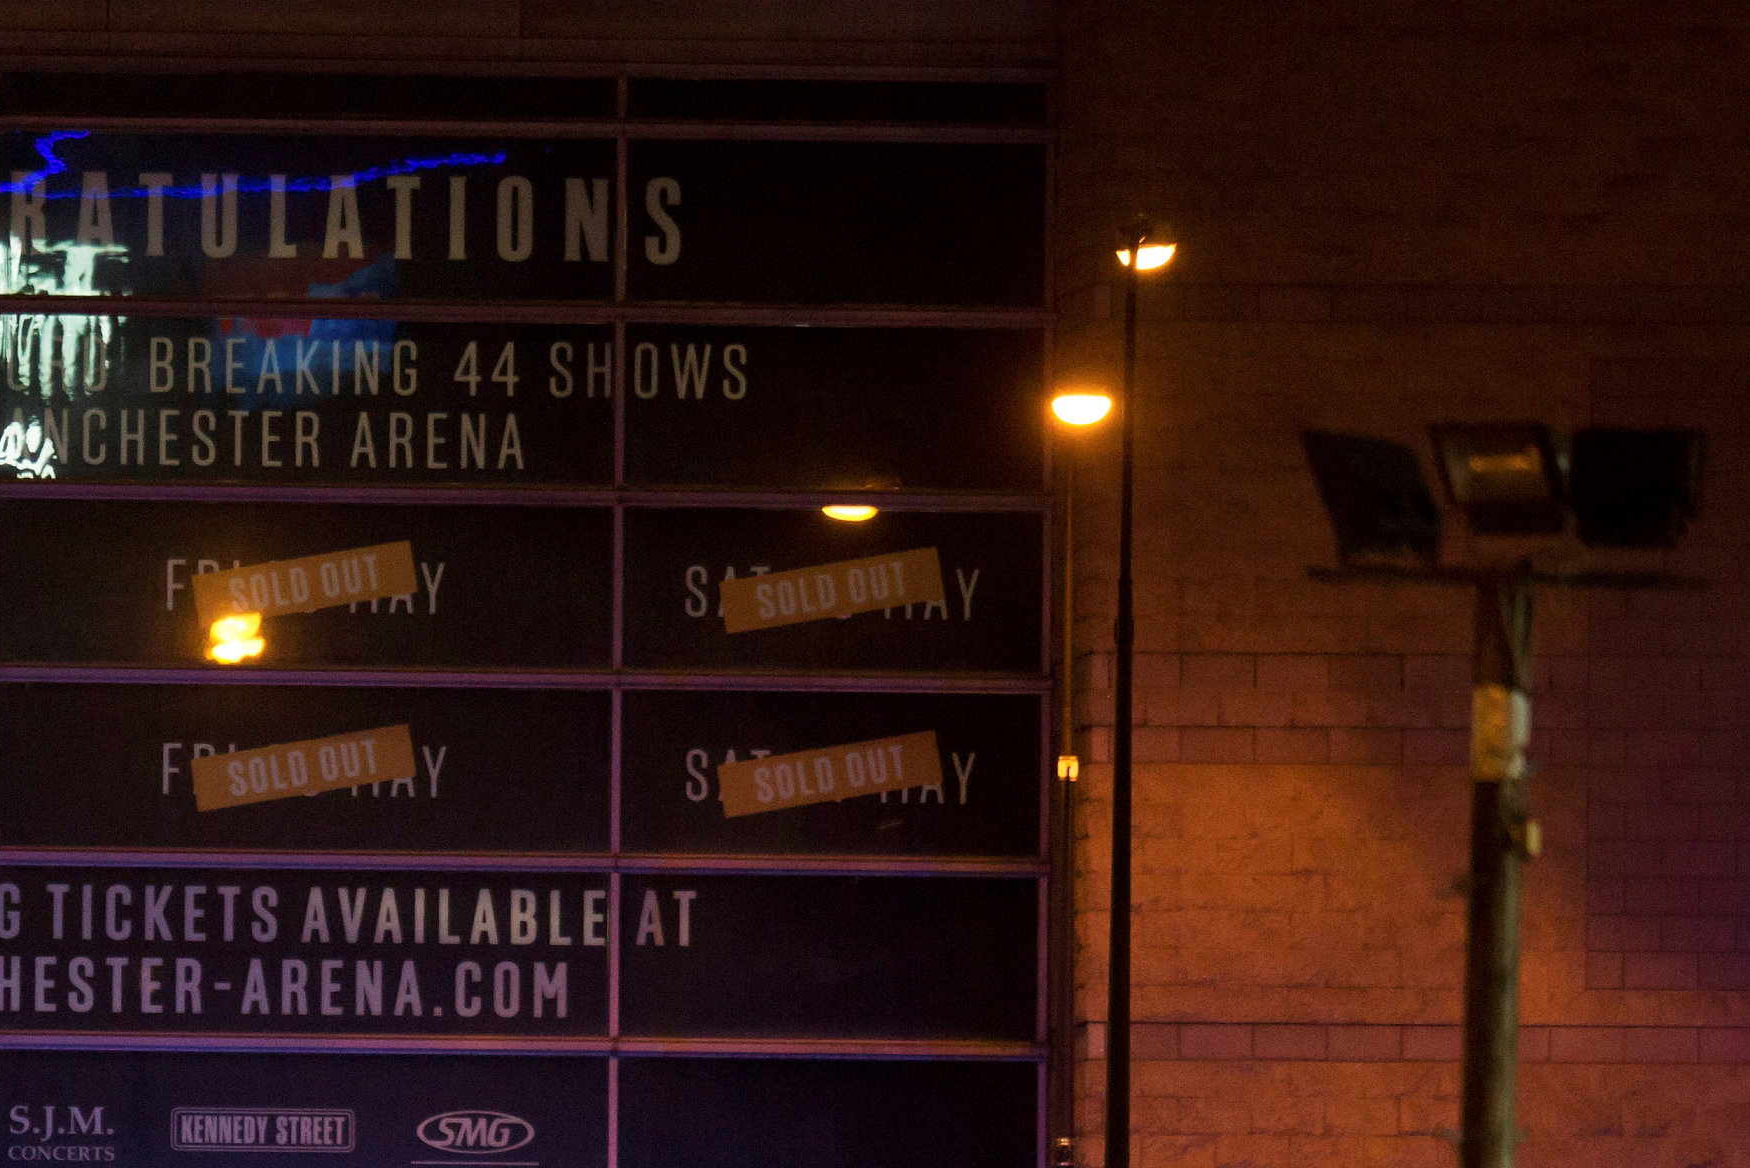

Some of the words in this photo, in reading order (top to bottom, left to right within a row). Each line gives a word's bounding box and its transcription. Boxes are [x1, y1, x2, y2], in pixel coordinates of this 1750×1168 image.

[148, 336, 418, 396] BREAKING
[453, 340, 520, 397] 44
[548, 341, 749, 401] SHOWS
[349, 411, 526, 471] ARENA
[227, 566, 310, 612] SOLD
[319, 554, 379, 598] OUT
[754, 573, 837, 620] SOLD
[846, 561, 906, 605] OUT
[226, 750, 310, 797] SOLD
[318, 738, 378, 782] OUT
[753, 757, 837, 804] SOLD
[845, 744, 905, 789] OUT
[46, 883, 280, 943] TICKETS
[302, 886, 608, 947] AVAILABLE
[636, 889, 698, 947] AT
[8, 1105, 115, 1136] S.J.M.
[181, 1115, 268, 1144] KENNEDY
[276, 1115, 346, 1146] STREET
[434, 1116, 514, 1148] SMG
[7, 1145, 116, 1162] CONCERTS
